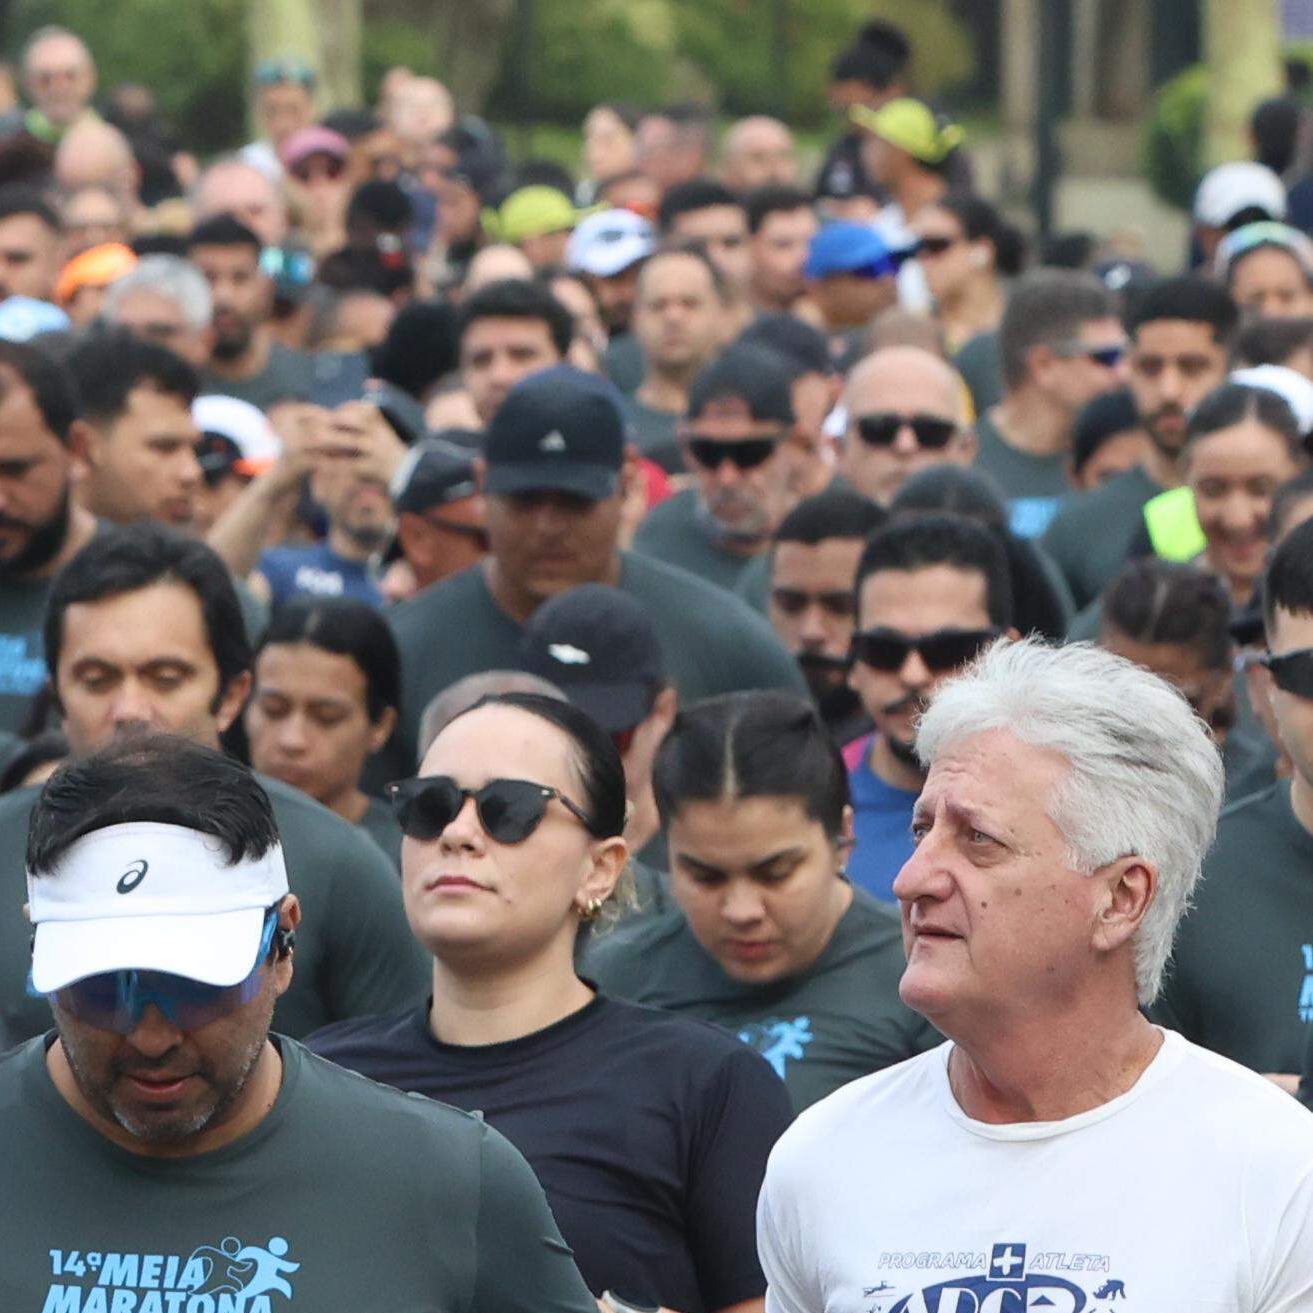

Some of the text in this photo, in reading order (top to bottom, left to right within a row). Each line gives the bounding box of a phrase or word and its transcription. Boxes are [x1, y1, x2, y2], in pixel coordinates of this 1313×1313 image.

[97, 1253, 205, 1290] MEIA
[877, 1252, 1110, 1272] PROGRAMA ATLETA
